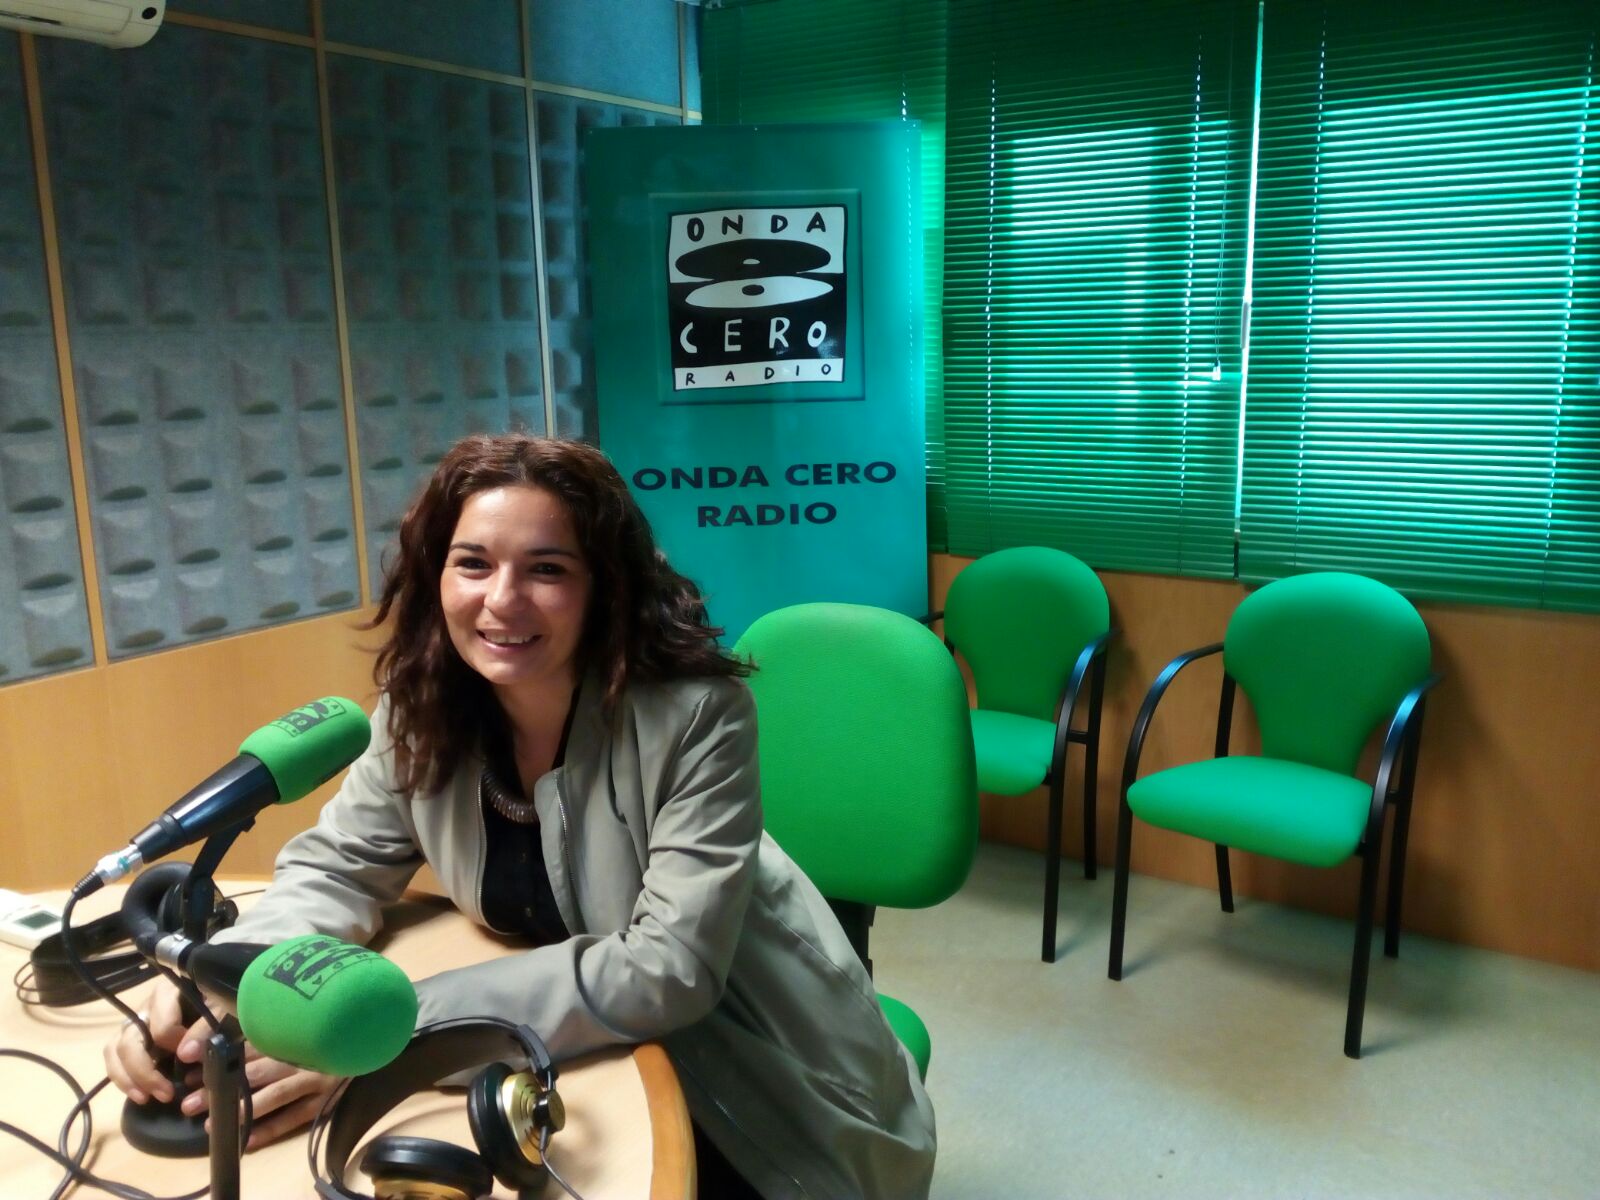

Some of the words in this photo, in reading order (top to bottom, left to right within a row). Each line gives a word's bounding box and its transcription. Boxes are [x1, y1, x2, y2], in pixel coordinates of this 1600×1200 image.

[686, 212, 827, 242] ONDA
[680, 317, 827, 354] CERO
[685, 363, 832, 386] RADIO
[632, 465, 769, 491] ONDA
[785, 461, 897, 486] CERO
[697, 502, 837, 528] RADIO
